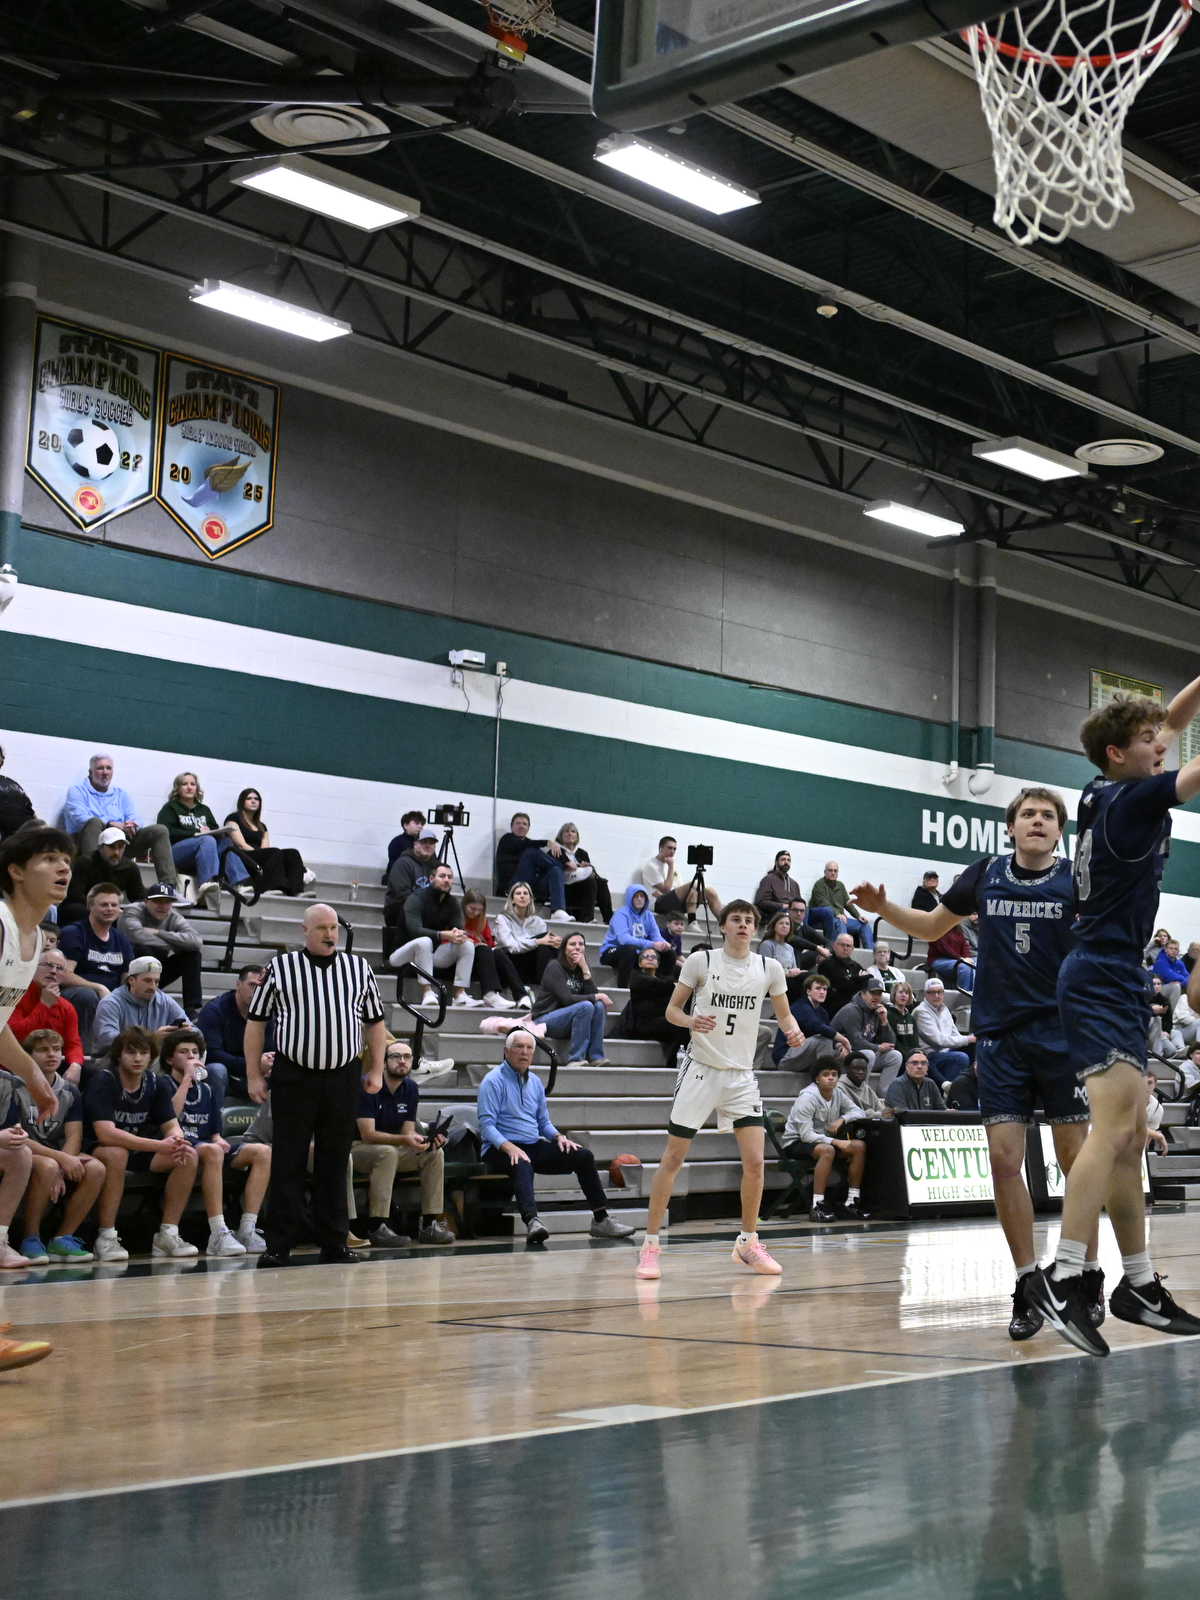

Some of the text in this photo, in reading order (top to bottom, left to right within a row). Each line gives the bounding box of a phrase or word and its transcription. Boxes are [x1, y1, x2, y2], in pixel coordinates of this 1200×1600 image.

[59, 333, 139, 375] STATE
[38, 356, 152, 420] CHAMPIONS
[185, 370, 259, 409] STATE
[94, 398, 134, 427] SOCCER
[168, 393, 271, 453] CHAMPIONS
[38, 430, 61, 451] 20
[120, 451, 144, 471] 22
[170, 463, 190, 484] 20
[244, 482, 263, 502] 25
[922, 809, 1014, 855] HOME
[986, 899, 1063, 919] MAVERICKS
[1015, 923, 1031, 954] 5
[711, 992, 756, 1010] KNIGHTS
[725, 1014, 737, 1035] 5
[922, 1128, 985, 1142] WELCOME
[907, 1147, 989, 1181] CENTU
[927, 1186, 959, 1200] HIGH
